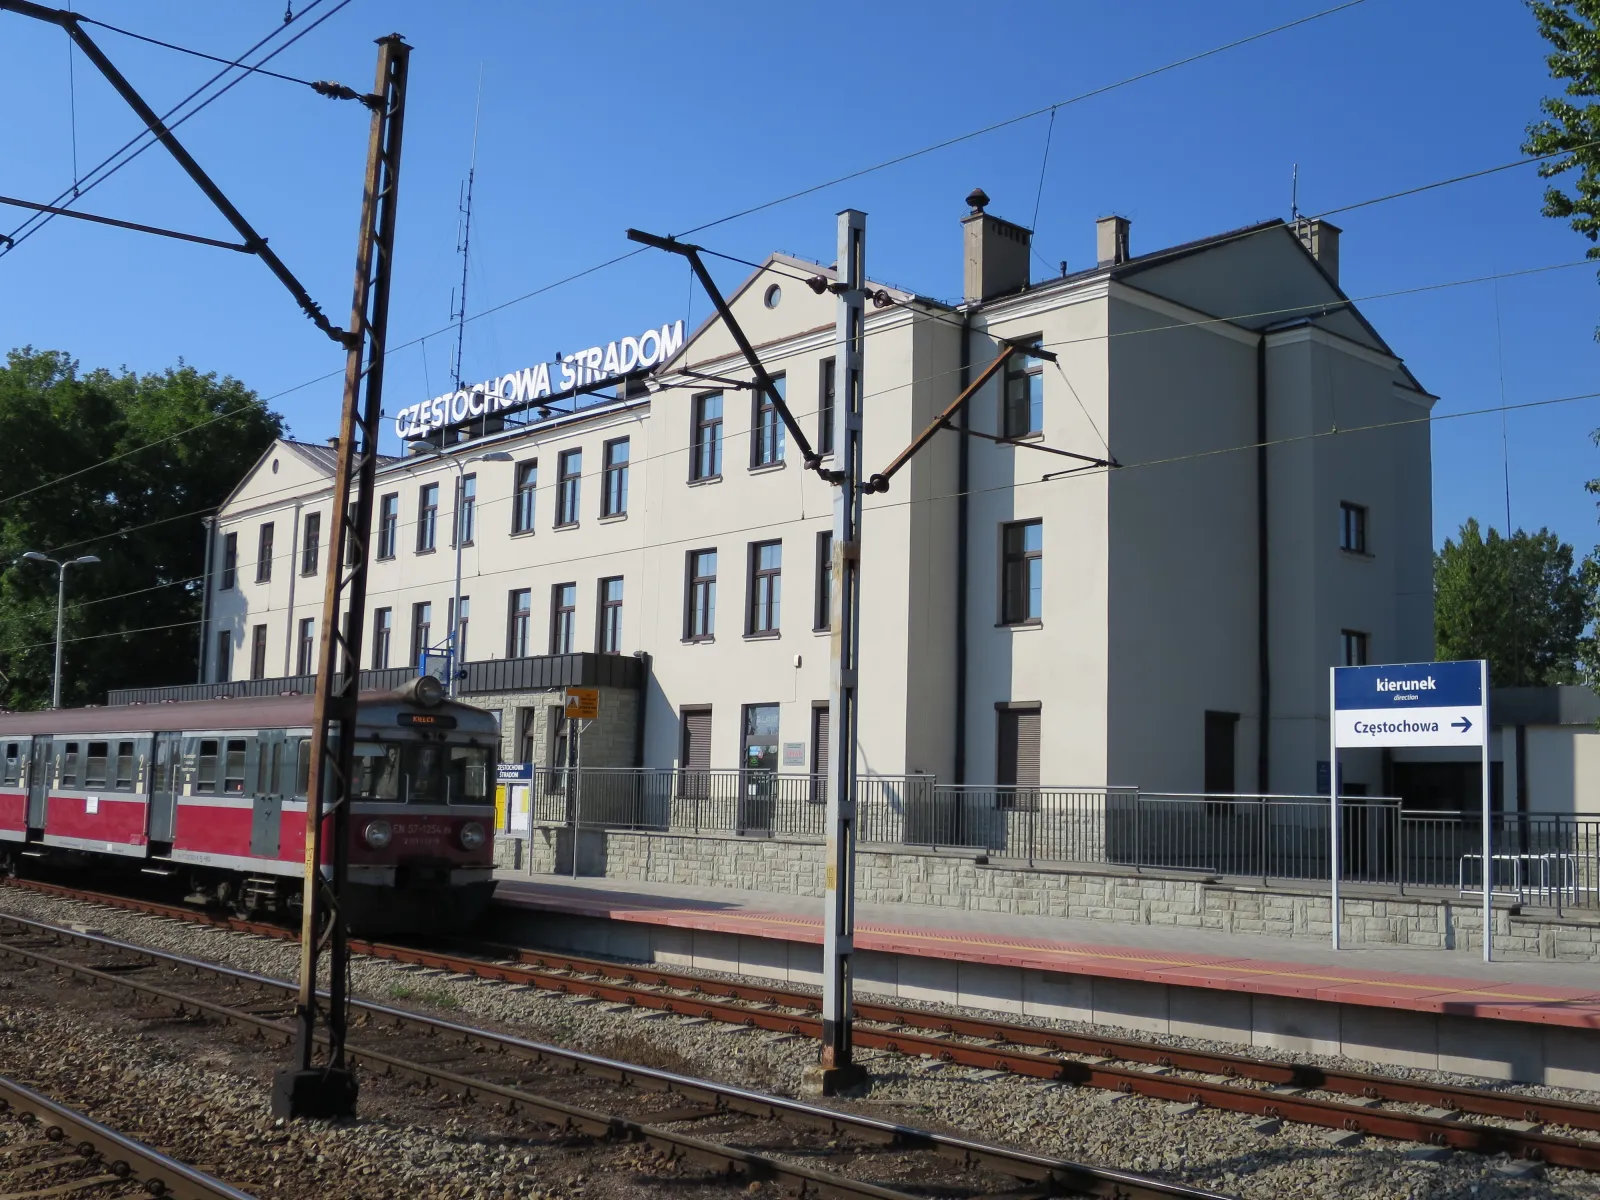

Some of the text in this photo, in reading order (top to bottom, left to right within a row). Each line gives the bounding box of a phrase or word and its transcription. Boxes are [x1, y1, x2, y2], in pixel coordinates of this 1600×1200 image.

[395, 320, 685, 439] CZĘSTOCHOWA STRADOM
[1376, 676, 1437, 692] kierunek
[1354, 719, 1439, 737] Częstochowa
[55, 753, 61, 769] 2
[138, 754, 144, 770] 2
[393, 824, 405, 834] EN
